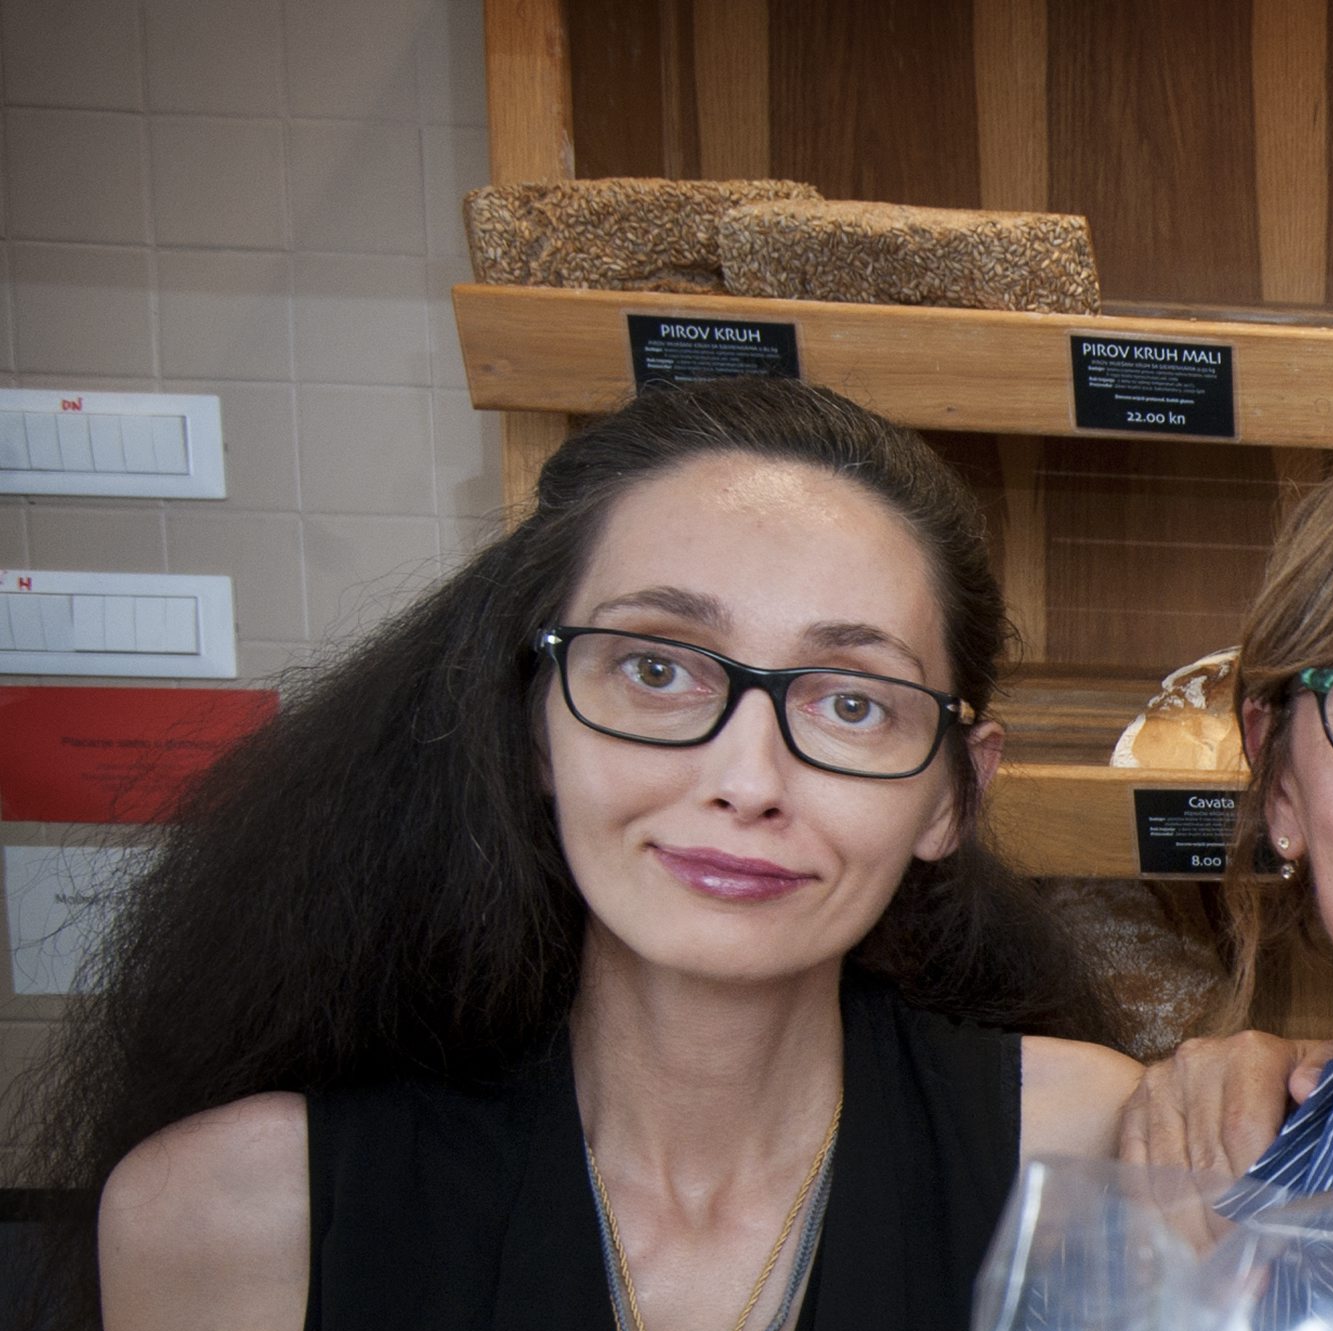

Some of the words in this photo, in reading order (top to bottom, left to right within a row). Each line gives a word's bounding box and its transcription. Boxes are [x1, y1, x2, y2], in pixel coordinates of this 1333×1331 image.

[660, 324, 710, 340] PIROV
[714, 327, 761, 342] KRUH
[1082, 342, 1130, 358] PIROV
[1134, 346, 1179, 361] KRUH
[1182, 349, 1222, 365] MALI
[1127, 411, 1165, 424] 22.00
[1169, 411, 1186, 425] kn
[1188, 796, 1235, 809] Cavata
[1191, 855, 1222, 867] 8.00
